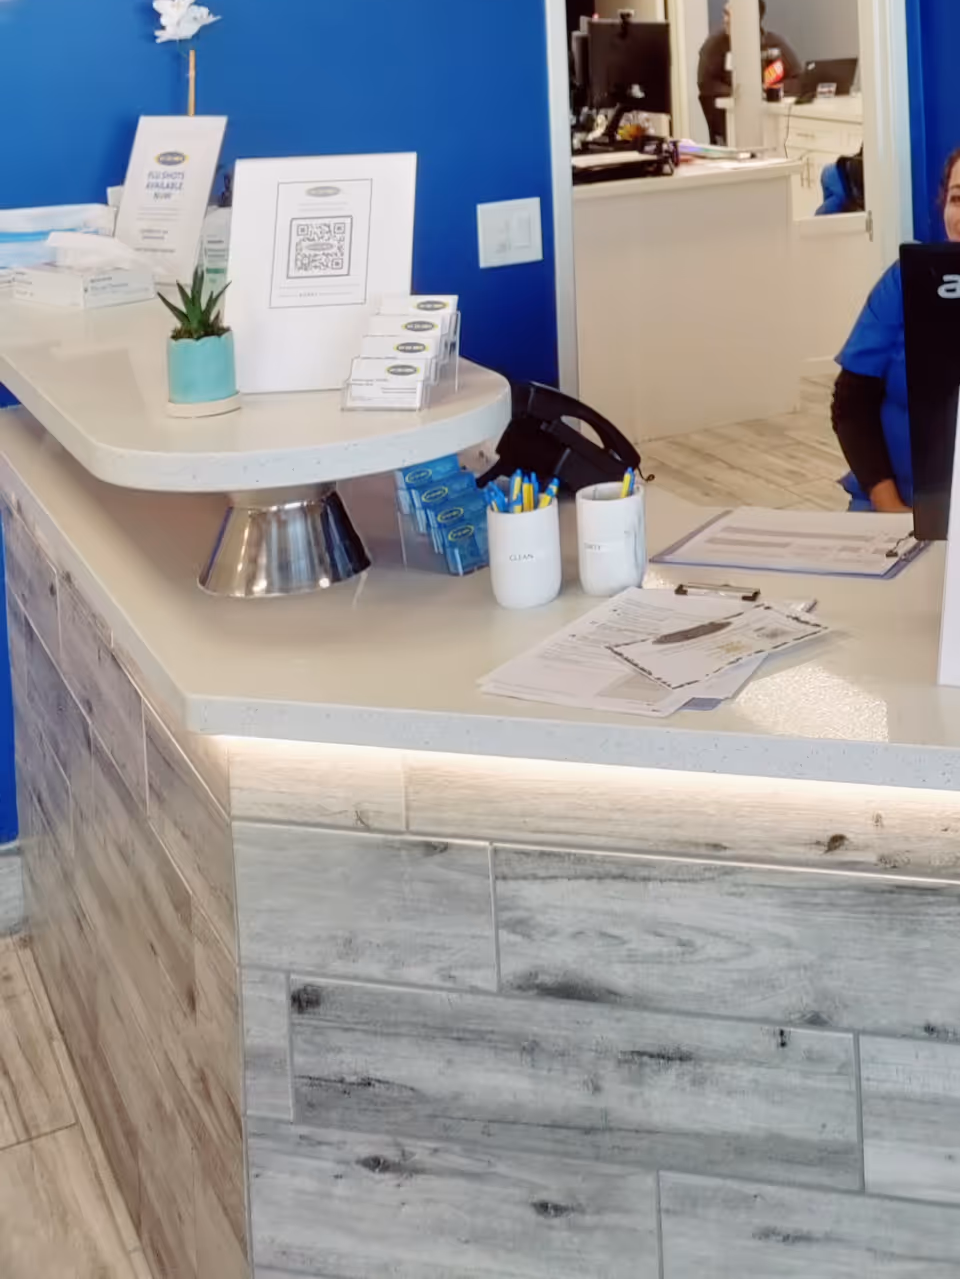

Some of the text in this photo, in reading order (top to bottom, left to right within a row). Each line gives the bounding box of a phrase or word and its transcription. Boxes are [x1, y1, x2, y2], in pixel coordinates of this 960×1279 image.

[162, 171, 184, 180] SHOTS
[146, 181, 182, 191] AVAILABLE
[509, 554, 534, 562] CLEAN
